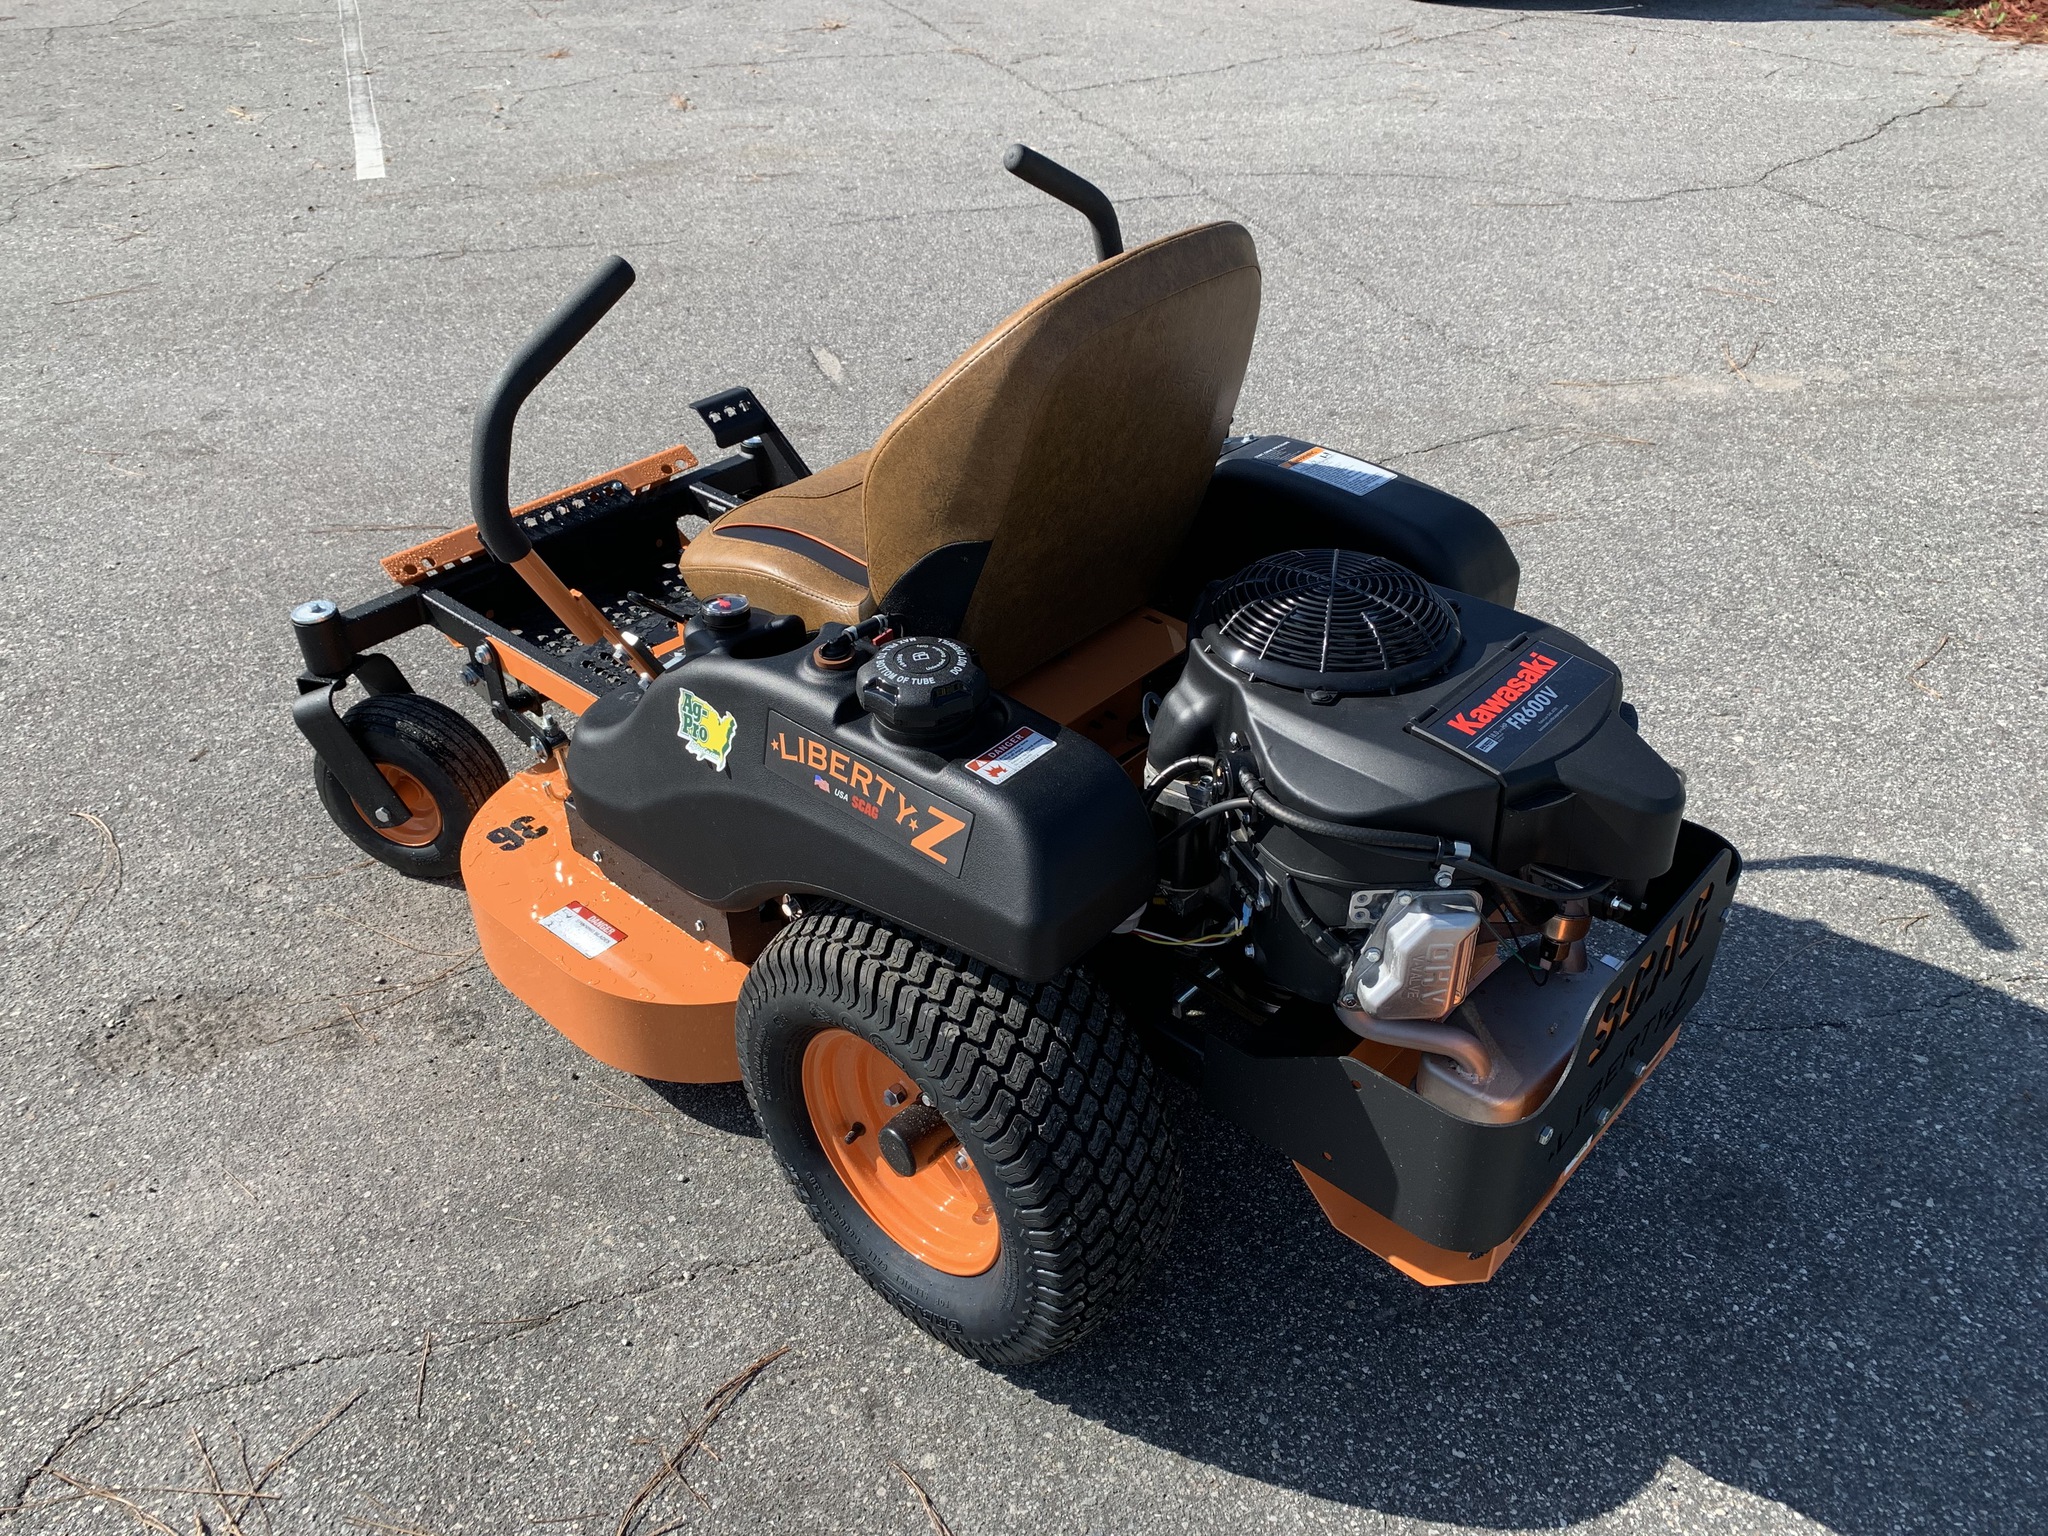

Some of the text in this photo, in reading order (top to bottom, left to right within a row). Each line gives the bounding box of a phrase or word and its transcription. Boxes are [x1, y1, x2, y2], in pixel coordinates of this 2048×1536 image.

[898, 637, 916, 645] MAX
[875, 660, 898, 680] BOTTOM
[937, 638, 968, 676] DO NOT OVERFILL
[897, 675, 909, 683] OF
[911, 677, 936, 685] TUBE
[1447, 651, 1558, 736] Kawasaki
[682, 694, 708, 721] Ag-
[1506, 685, 1558, 730] FR600V
[682, 716, 708, 742] Pro
[988, 734, 1025, 758] DANGER
[778, 732, 966, 865] LIBERTY Z
[834, 788, 879, 820] USA SCAG
[486, 815, 549, 852] 36
[587, 915, 616, 936] DANGER
[1421, 943, 1454, 1005] OHV
[1587, 882, 1715, 1068] SCAG
[866, 1248, 888, 1272] CALL
